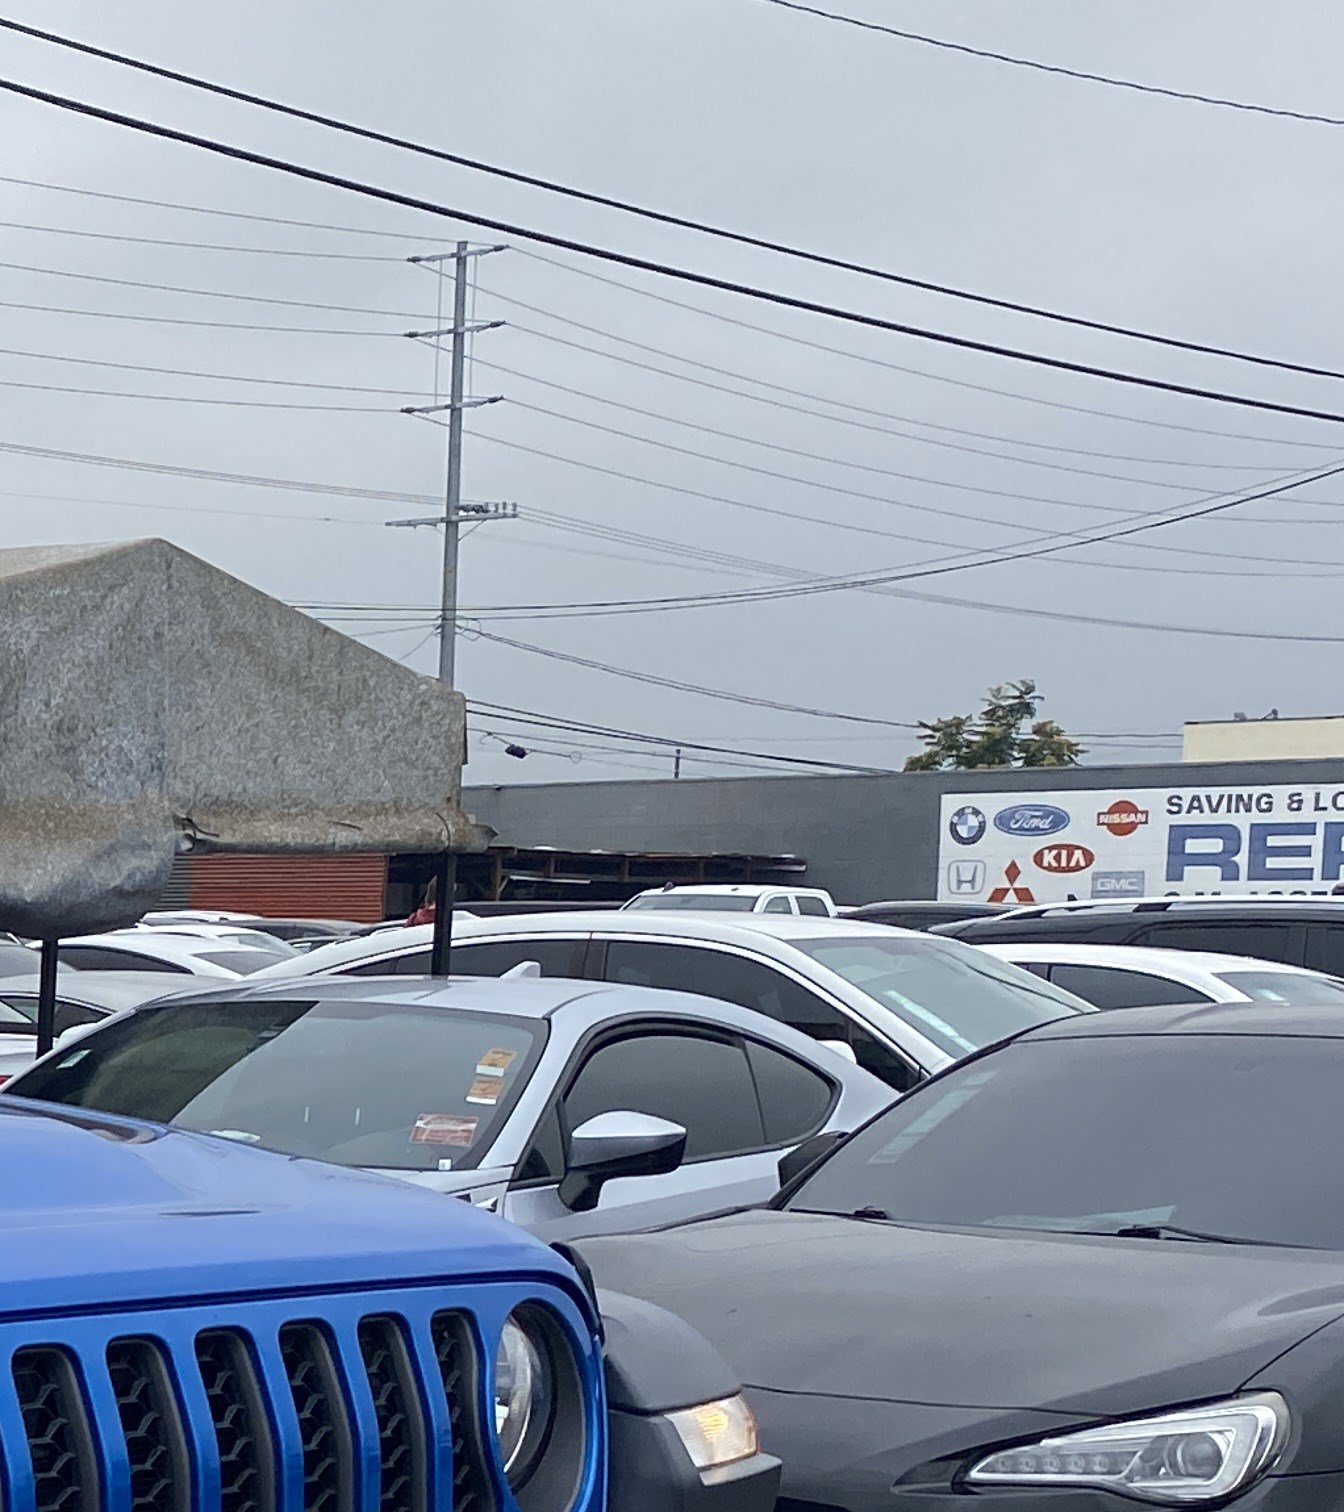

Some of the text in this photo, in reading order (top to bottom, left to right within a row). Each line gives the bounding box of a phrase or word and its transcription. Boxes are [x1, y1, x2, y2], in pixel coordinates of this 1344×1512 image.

[1166, 793, 1274, 815] SAVING
[1286, 792, 1304, 812] &
[1010, 808, 1053, 830] Ford
[1098, 812, 1147, 824] NISSAN
[1042, 849, 1086, 868] KIA
[1097, 878, 1139, 891] GMC
